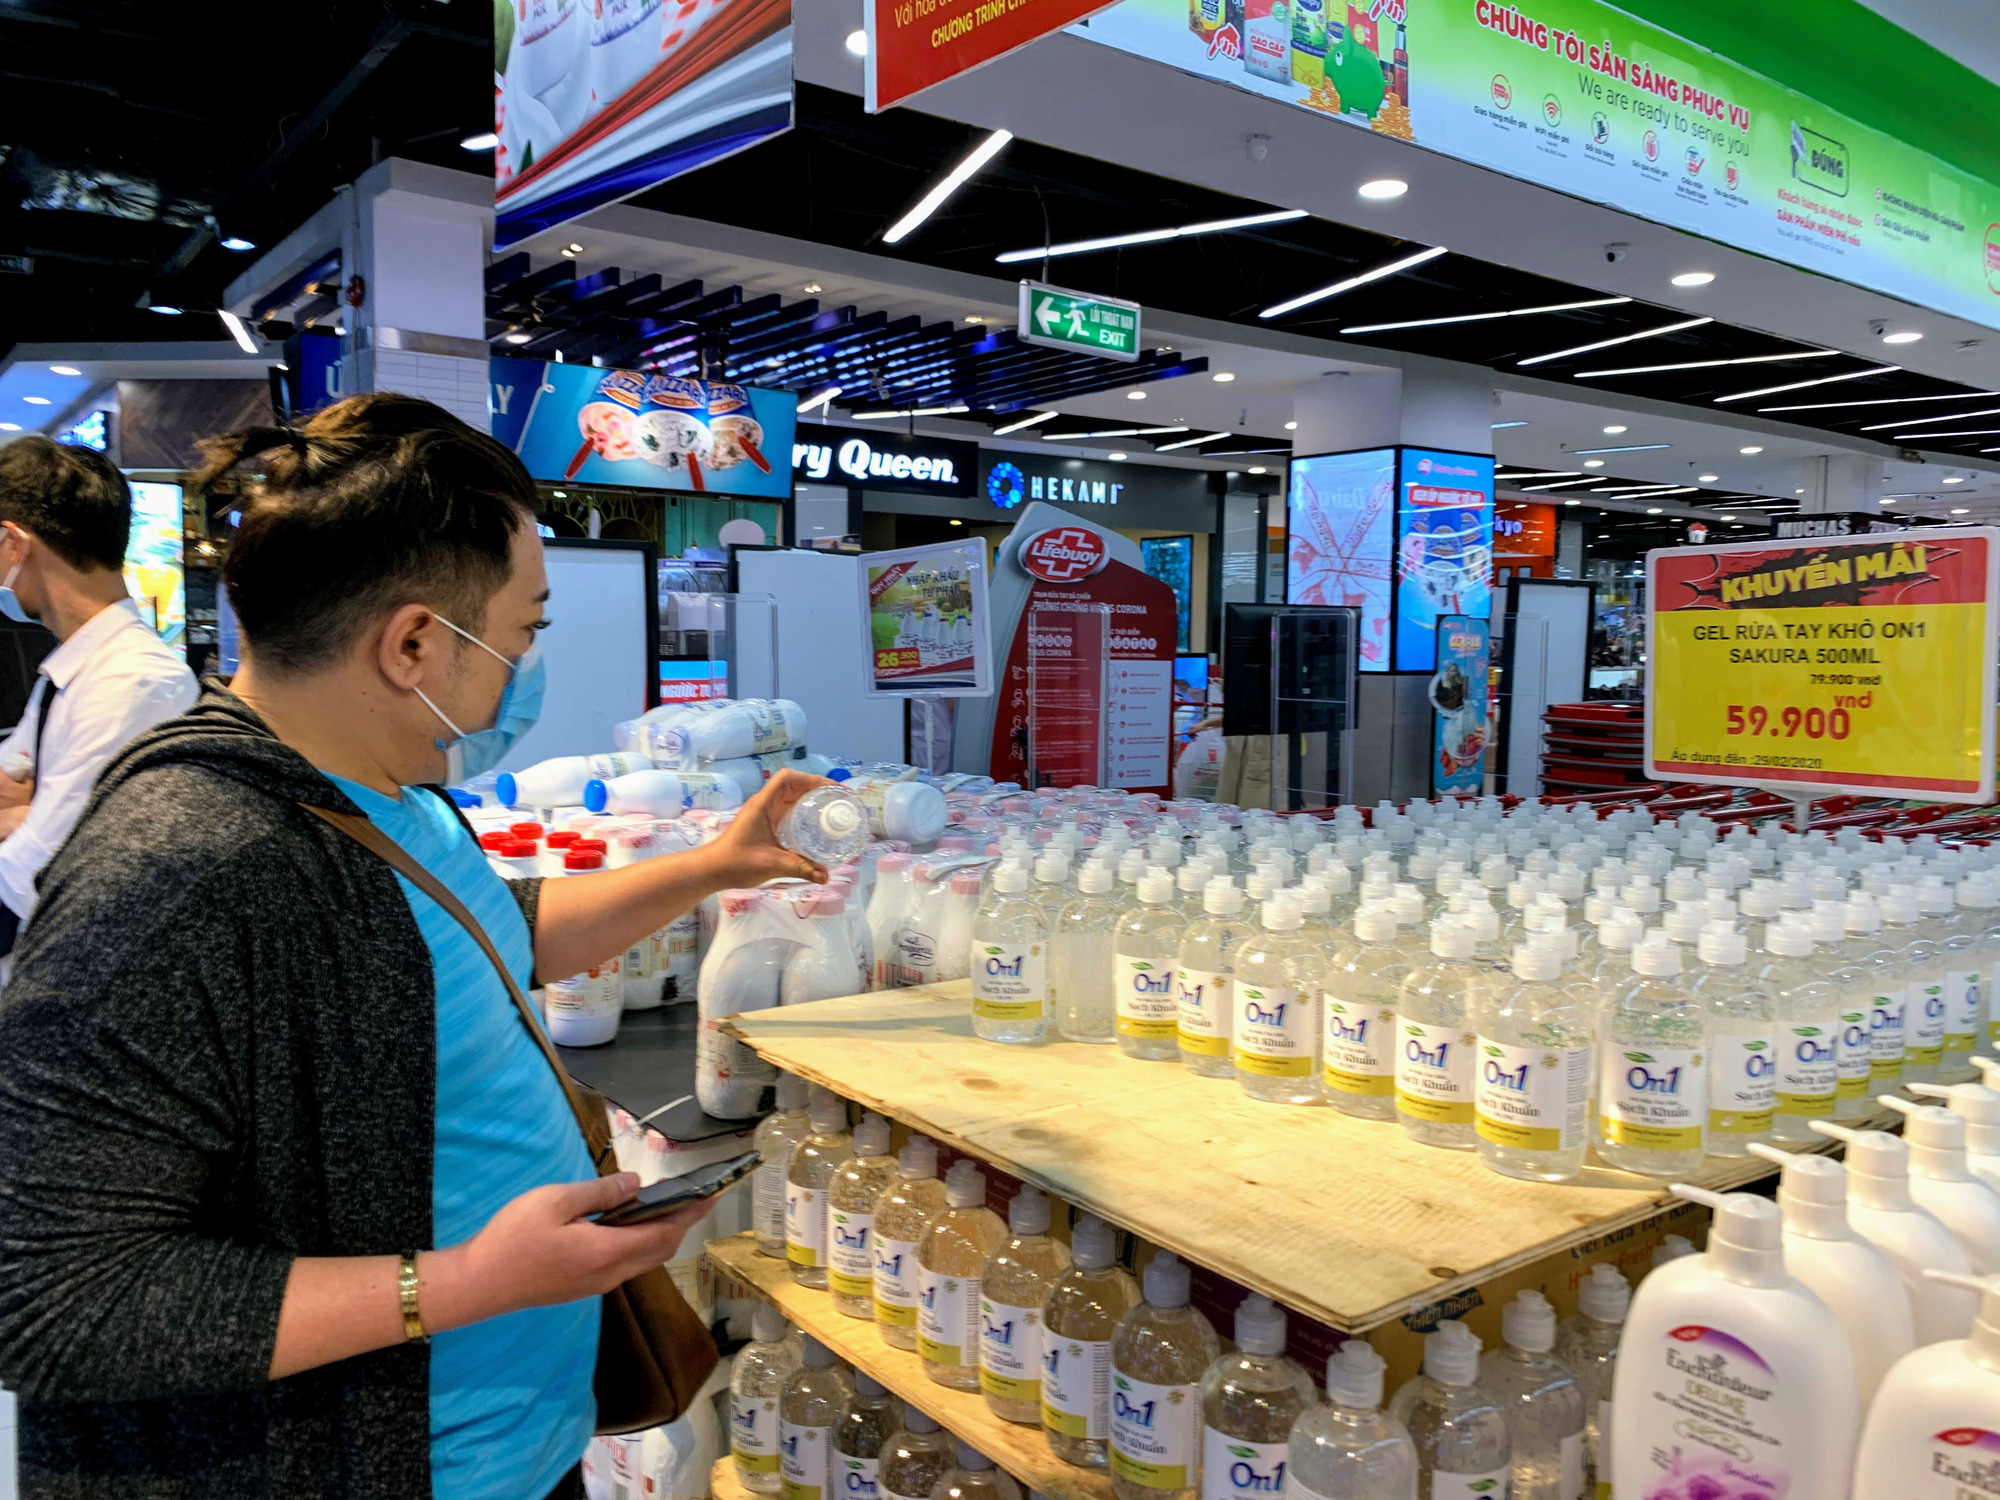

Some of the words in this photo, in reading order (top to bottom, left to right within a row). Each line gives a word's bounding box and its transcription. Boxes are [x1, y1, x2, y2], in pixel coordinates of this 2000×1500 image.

[894, 3, 913, 28] Với
[931, 12, 974, 48] CHƯƠNG
[974, 0, 1006, 27] TRÌNH
[1474, 0, 1549, 50] CHÚNG
[1551, 30, 1586, 65] TÔI
[1588, 41, 1628, 83] SẴN
[1630, 63, 1679, 103] SÀNG
[1681, 83, 1726, 122] PHỤC
[1727, 103, 1751, 137] VỤ
[1578, 72, 1603, 99] We
[1605, 89, 1630, 112] are
[1632, 100, 1671, 131] ready
[1674, 112, 1689, 135] to
[1690, 124, 1726, 149] serve
[1727, 136, 1751, 159] you
[1811, 148, 1844, 178] ĐÚNG
[1099, 329, 1126, 348] EXIT
[1776, 519, 1851, 538] MUCHAS
[1031, 541, 1102, 566] Lifebuoy
[1721, 553, 1851, 603] KHUYẾN
[1855, 543, 1929, 582] MÃI
[1116, 604, 1148, 615] CORONA
[1693, 625, 1730, 641] GEL
[1735, 621, 1775, 641] RỬA
[1785, 624, 1823, 640] TAY
[1828, 618, 1876, 638] KHÔ
[1882, 621, 1926, 638] ON1
[877, 652, 899, 667] 26
[1729, 648, 1808, 664] SAKURA
[1815, 648, 1881, 664] 500ML
[1810, 674, 1853, 685] 79.900
[1858, 674, 1881, 686] vnd
[1834, 690, 1872, 708] vnd
[1726, 705, 1851, 740] 59.900
[985, 955, 1024, 977] On1
[1133, 971, 1173, 996] On1
[1245, 1001, 1287, 1028] On1
[1329, 1016, 1370, 1044] On1
[1404, 1039, 1450, 1069] On1
[1484, 1060, 1530, 1092] On1
[1627, 1066, 1681, 1094] On1
[833, 1224, 870, 1250] On1
[1666, 1346, 1775, 1402] Enchanteur
[1113, 1391, 1156, 1429] On1
[1230, 1461, 1287, 1492] On1
